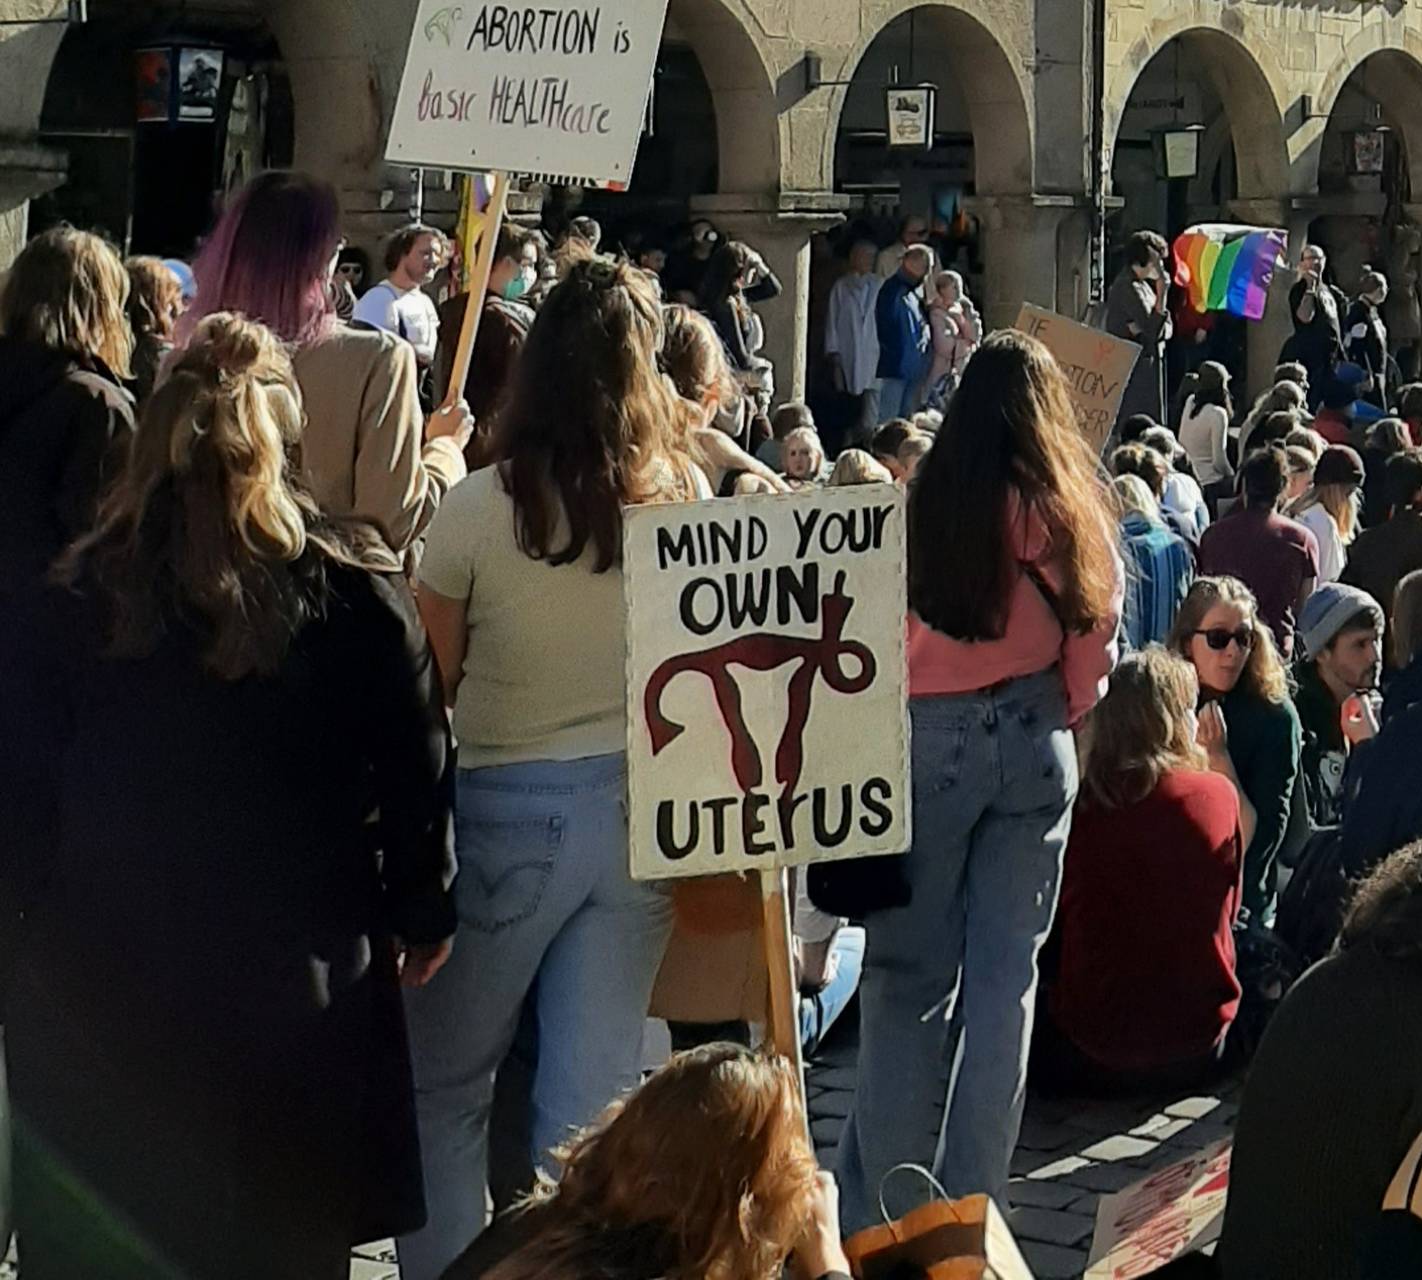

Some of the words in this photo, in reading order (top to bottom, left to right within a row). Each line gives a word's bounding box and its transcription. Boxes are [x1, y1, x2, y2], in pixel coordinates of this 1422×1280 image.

[467, 5, 600, 54] ABORTION
[614, 21, 631, 54] is
[489, 75, 612, 134] HEALTHcare
[657, 514, 768, 570] MIND
[679, 562, 819, 636] OWN
